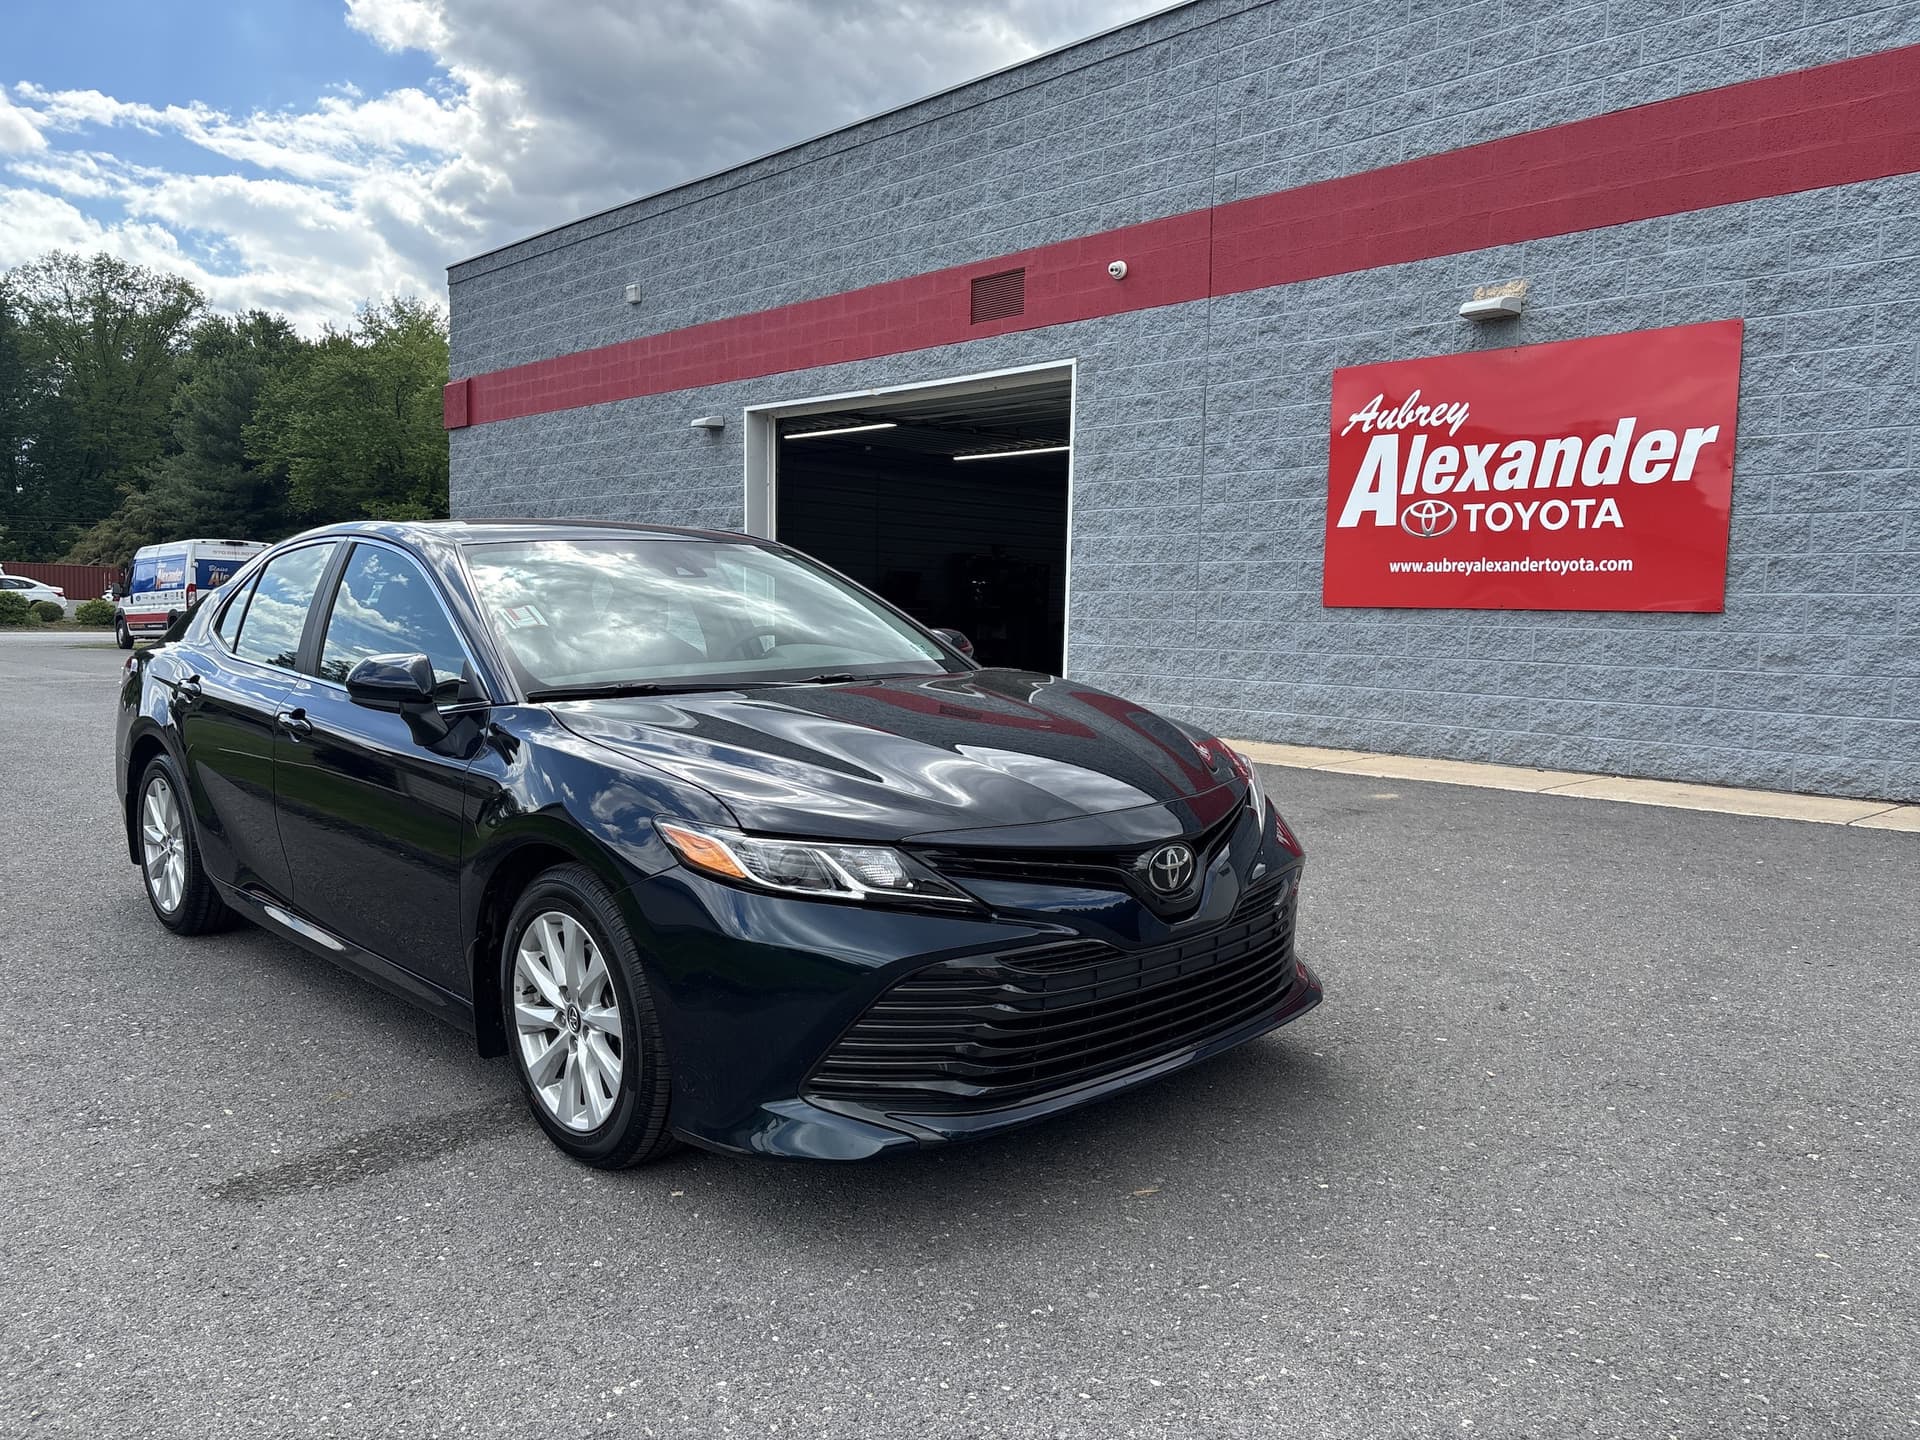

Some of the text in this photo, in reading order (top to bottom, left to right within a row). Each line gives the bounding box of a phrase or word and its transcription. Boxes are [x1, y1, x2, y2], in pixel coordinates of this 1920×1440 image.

[1341, 389, 1470, 437] Aubrey
[1337, 417, 1720, 528] Alexander
[1463, 499, 1624, 532] TOYOTA
[1389, 557, 1633, 576] www.aubreyalexandertoyota.com
